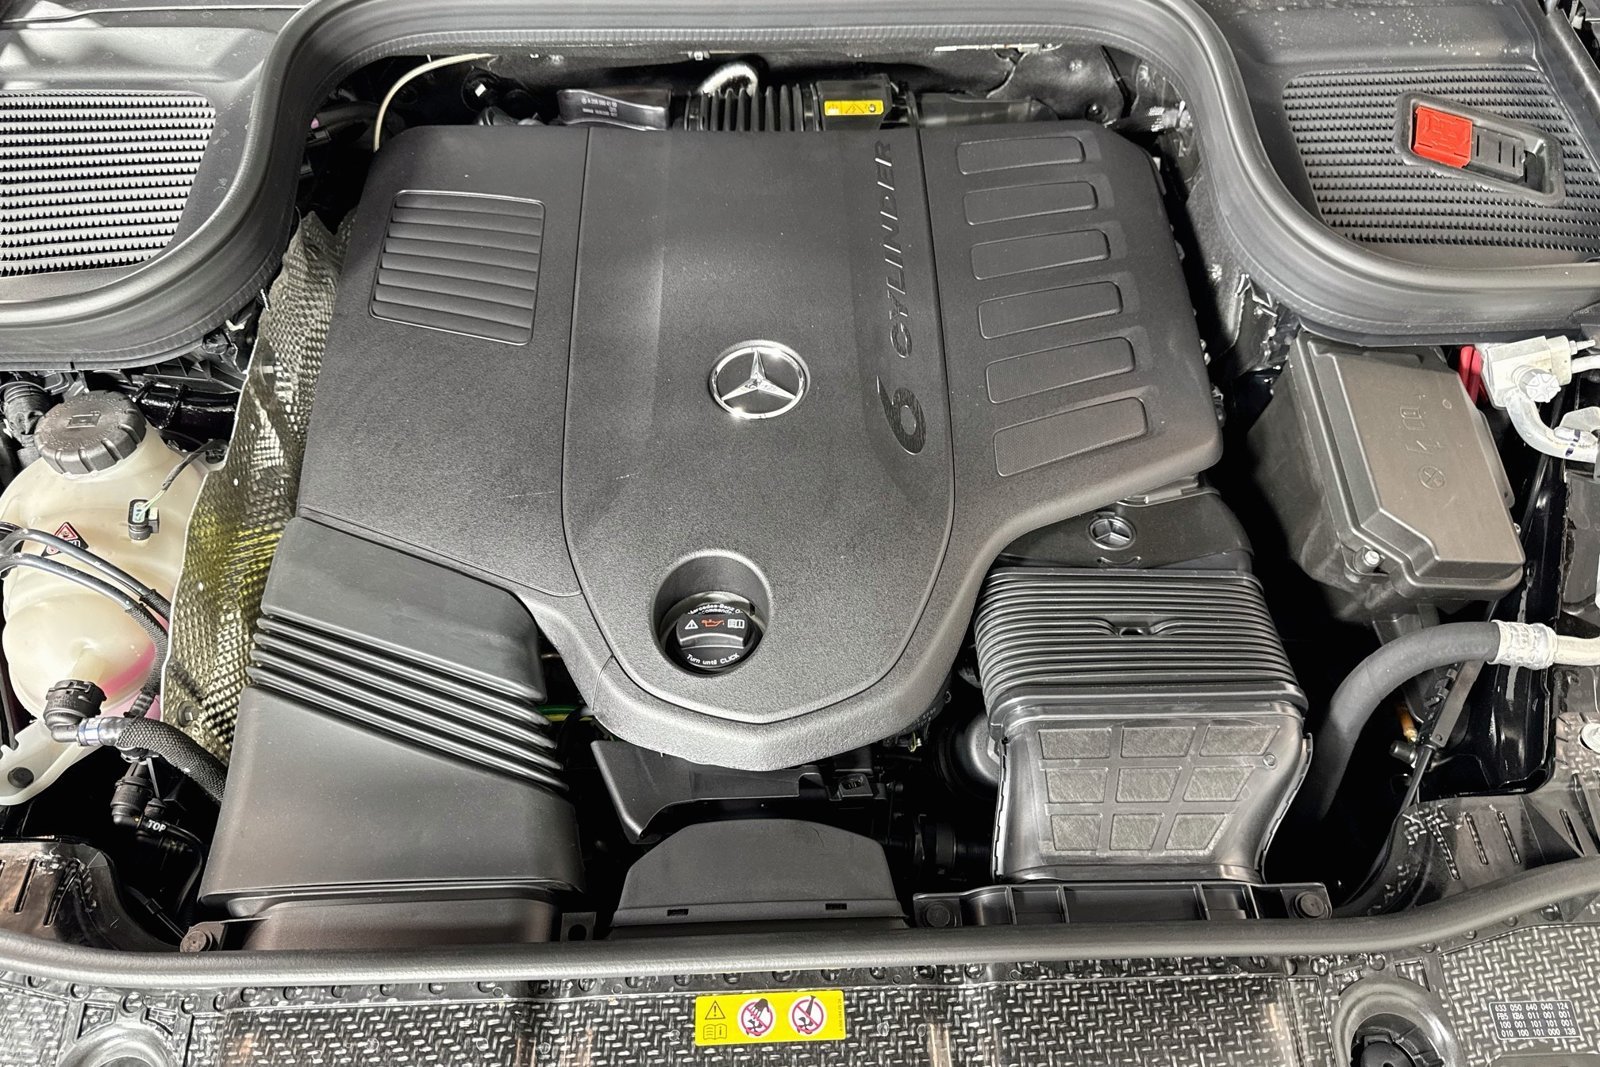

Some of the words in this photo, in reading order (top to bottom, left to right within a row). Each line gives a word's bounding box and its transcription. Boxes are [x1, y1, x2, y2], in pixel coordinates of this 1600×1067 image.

[874, 140, 913, 358] CYLINDER
[876, 375, 927, 456] 6
[687, 653, 701, 664] Turn
[720, 653, 740, 665] CLICK
[148, 819, 167, 832] TOP
